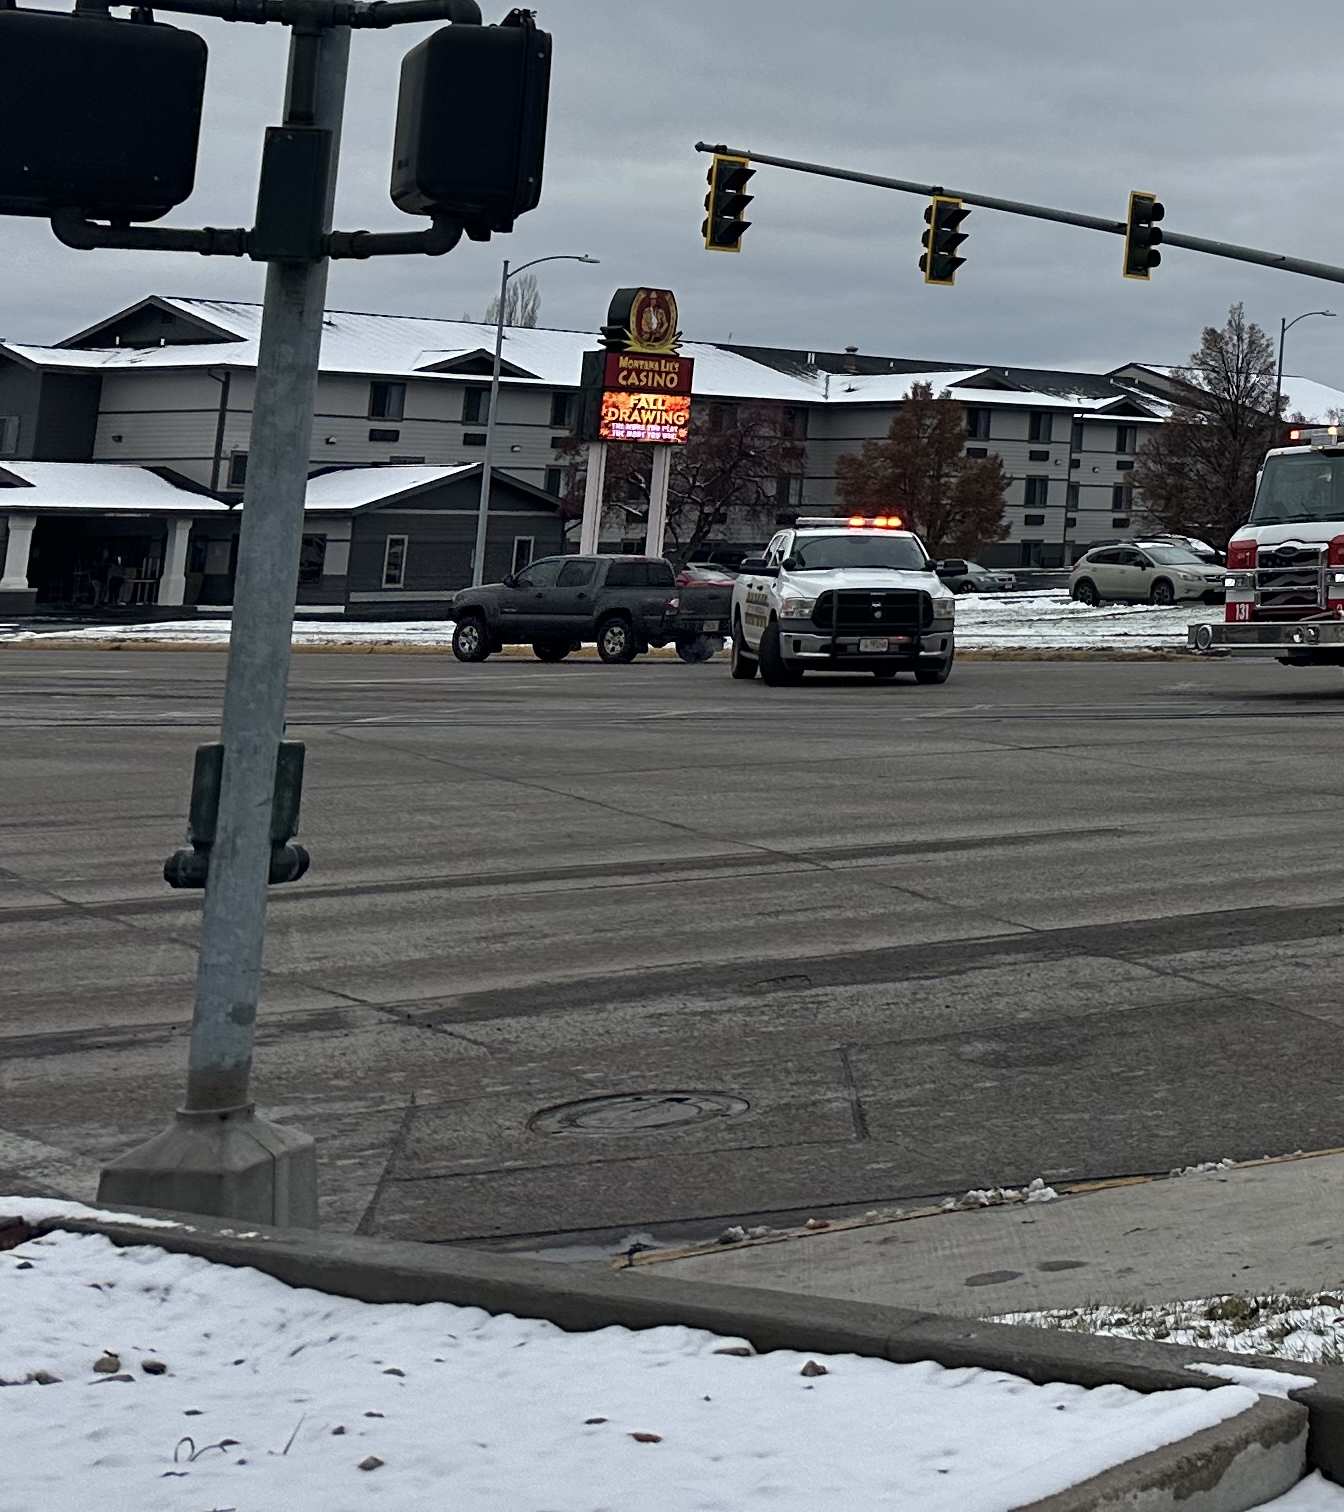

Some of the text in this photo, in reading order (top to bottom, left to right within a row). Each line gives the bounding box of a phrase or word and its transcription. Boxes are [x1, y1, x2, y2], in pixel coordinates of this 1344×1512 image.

[619, 356, 659, 371] MONTANA
[618, 370, 678, 388] CASINO
[630, 393, 666, 410] FALL
[607, 407, 685, 425] DRAWING
[1235, 603, 1250, 621] 131
